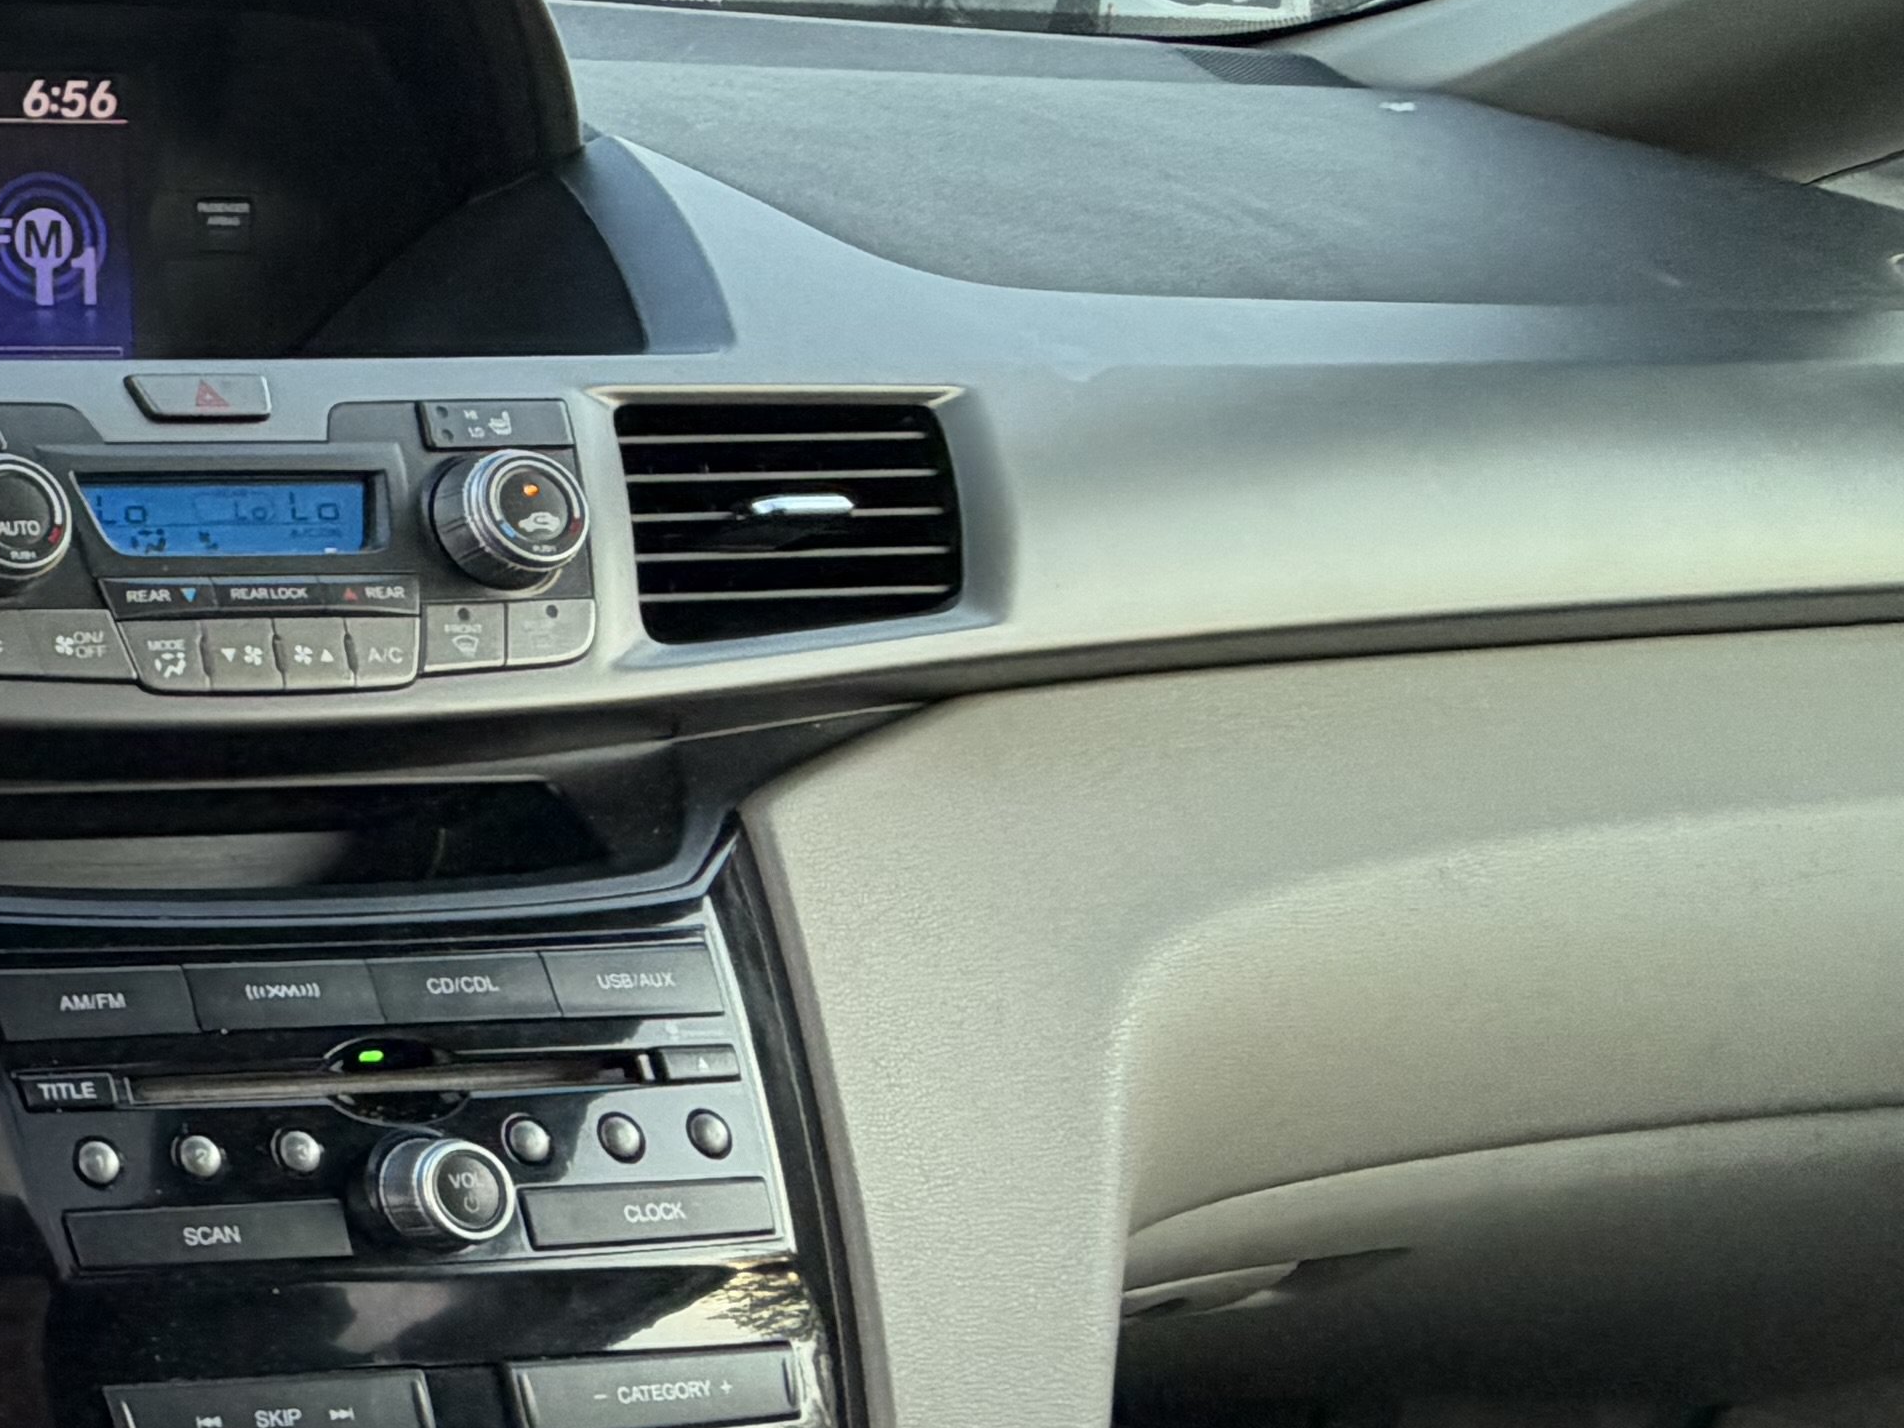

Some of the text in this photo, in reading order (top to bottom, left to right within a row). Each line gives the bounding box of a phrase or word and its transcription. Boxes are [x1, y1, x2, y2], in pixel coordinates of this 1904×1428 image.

[22, 79, 119, 119] 6:56
[126, 589, 171, 603] REAR
[230, 587, 308, 600] REAR LOCK
[364, 586, 405, 599] REAR
[74, 645, 108, 659] OFF
[147, 639, 185, 651] MODE
[366, 646, 404, 664] A/C
[425, 975, 500, 996] CD/CDL
[597, 972, 676, 991] USB/AUX
[59, 990, 127, 1014] AM/FM
[36, 1079, 96, 1101] TITLE
[447, 1171, 486, 1191] VOL
[623, 1202, 686, 1224] CLOCK
[182, 1225, 242, 1248] SCAN
[616, 1379, 712, 1405] CATEGORY
